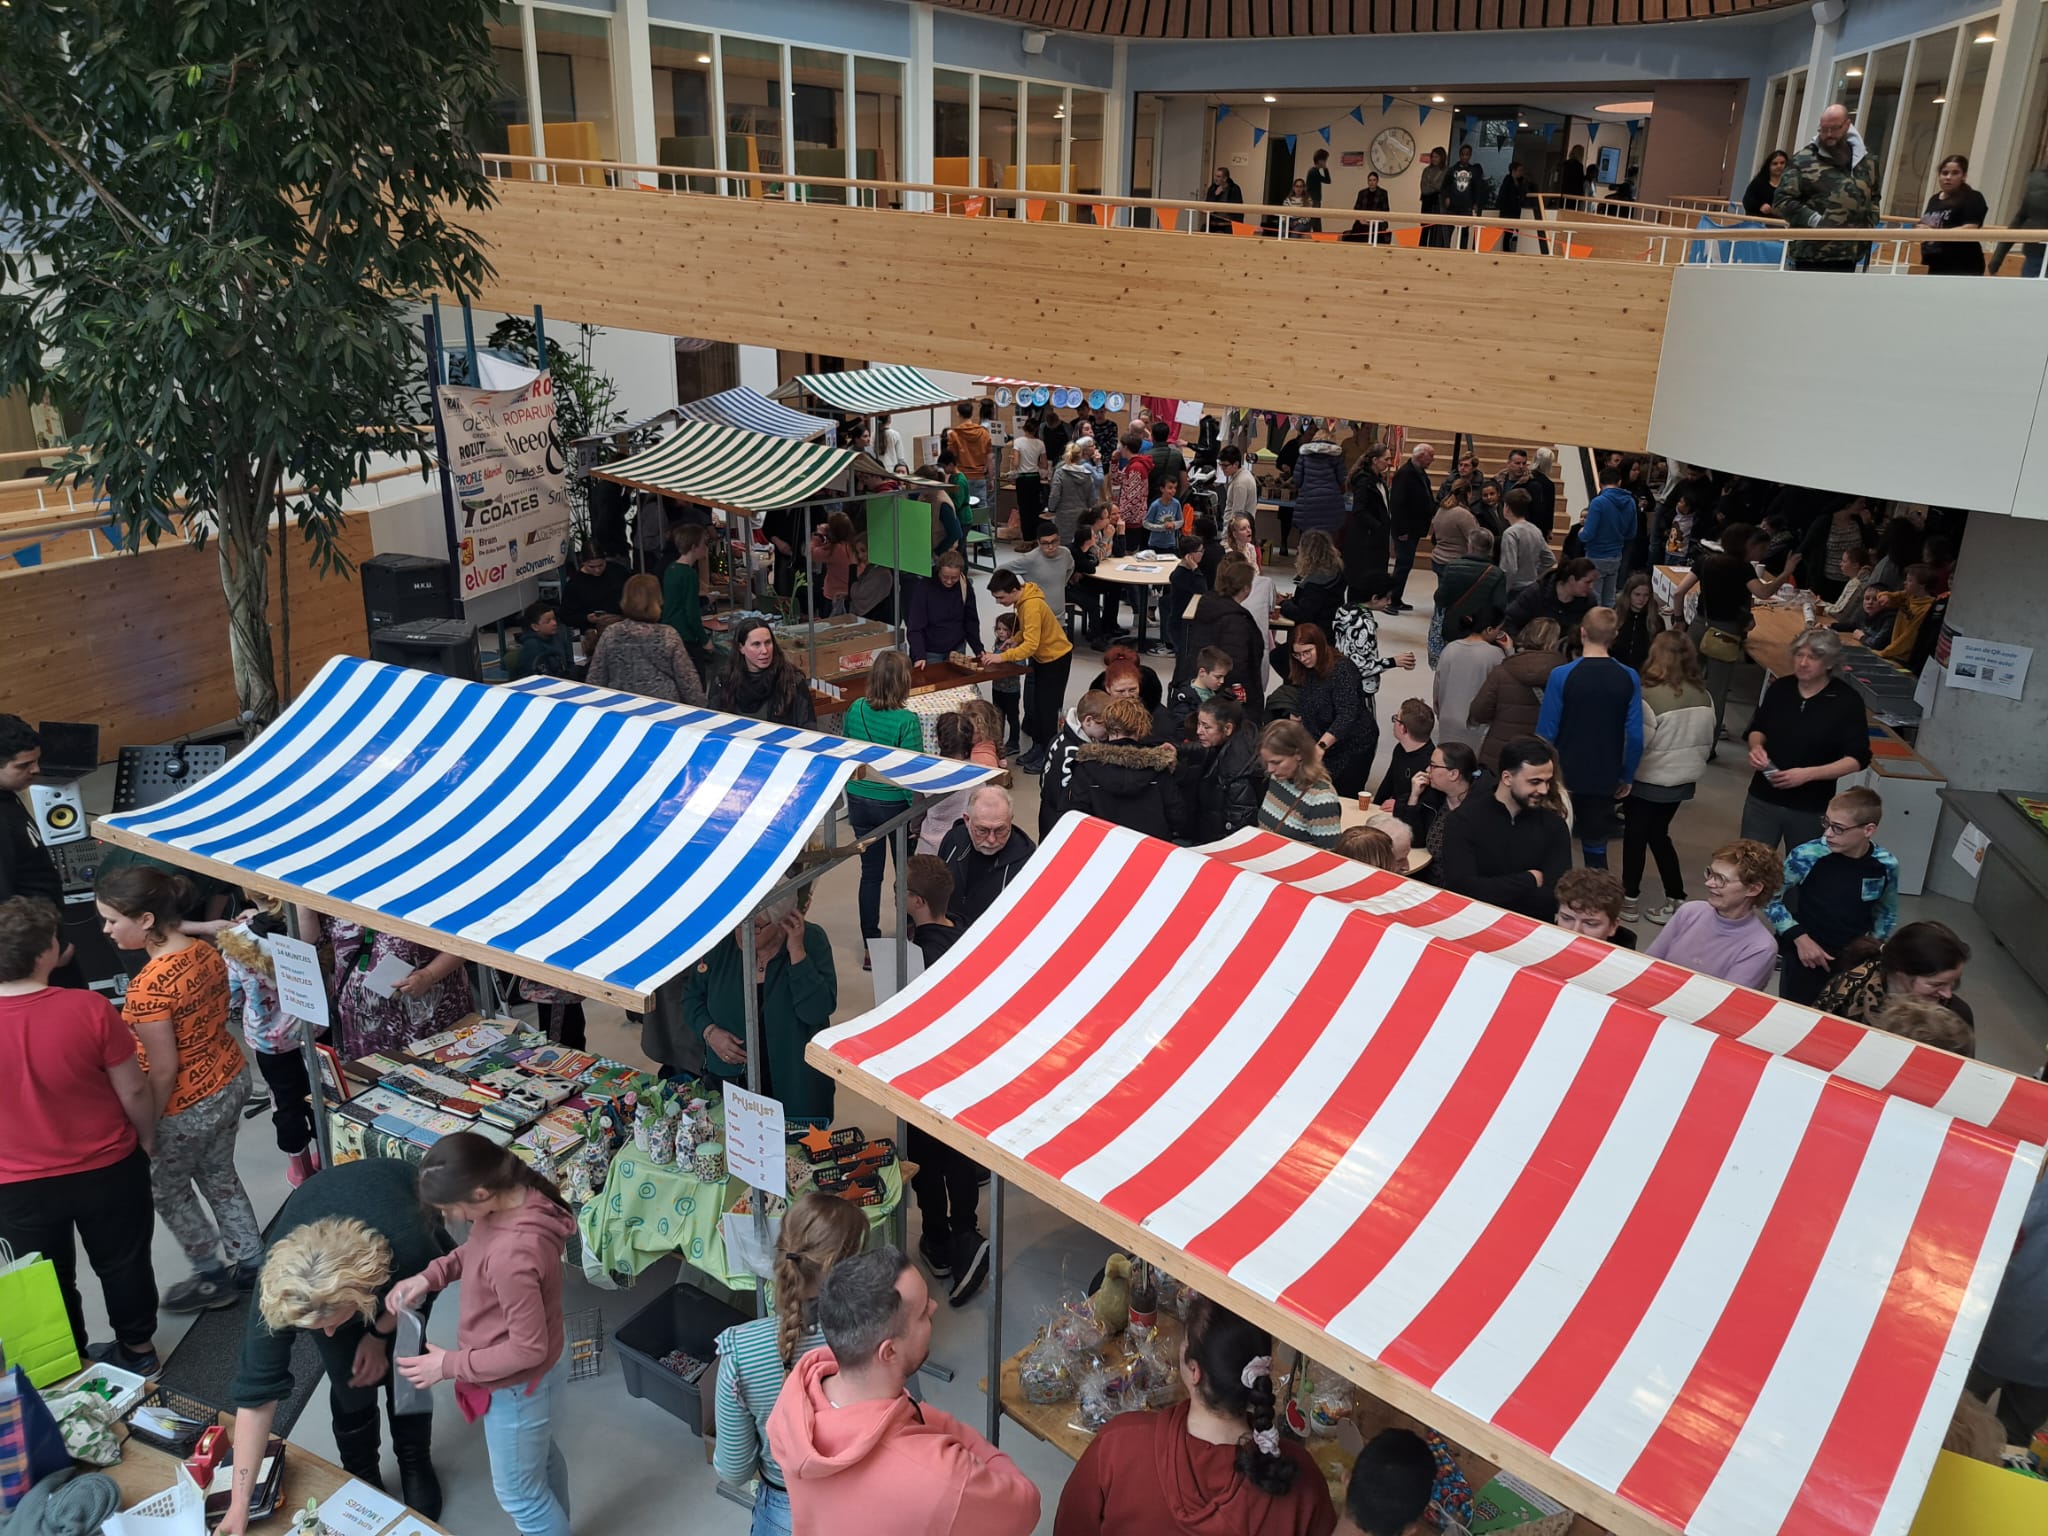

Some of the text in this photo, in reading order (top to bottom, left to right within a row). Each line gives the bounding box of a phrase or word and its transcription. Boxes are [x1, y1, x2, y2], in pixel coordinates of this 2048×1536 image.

[503, 402, 555, 427] ROPARUN
[480, 494, 540, 525] COATES
[465, 563, 508, 591] elver
[515, 554, 556, 577] ecoDynamic
[157, 954, 192, 986] Actie!
[176, 1072, 218, 1107] Actie!
